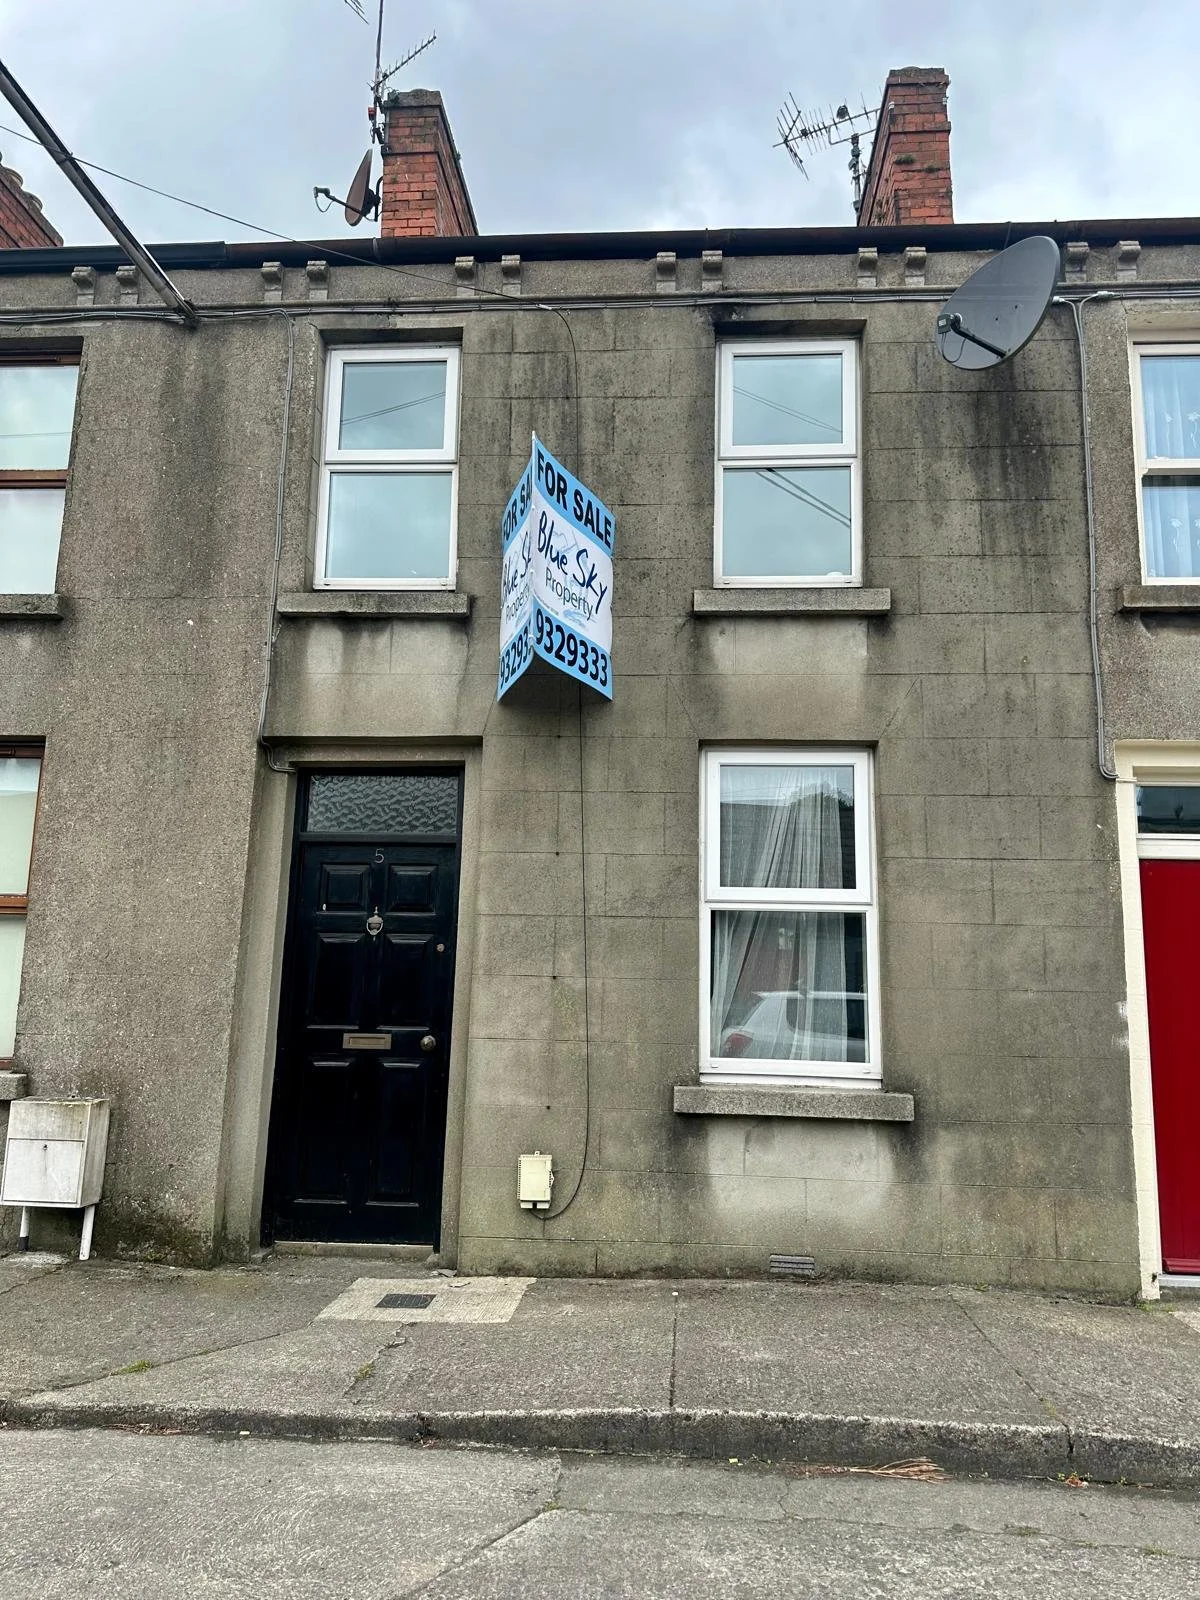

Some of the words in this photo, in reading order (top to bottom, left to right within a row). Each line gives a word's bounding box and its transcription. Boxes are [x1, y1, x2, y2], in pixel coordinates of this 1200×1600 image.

[537, 448, 568, 511] FOR
[573, 488, 612, 547] SALE
[537, 510, 569, 576] Blue
[545, 566, 594, 621] Property
[500, 619, 532, 690] 93293
[535, 608, 608, 688] 9329333
[375, 848, 385, 864] 5
